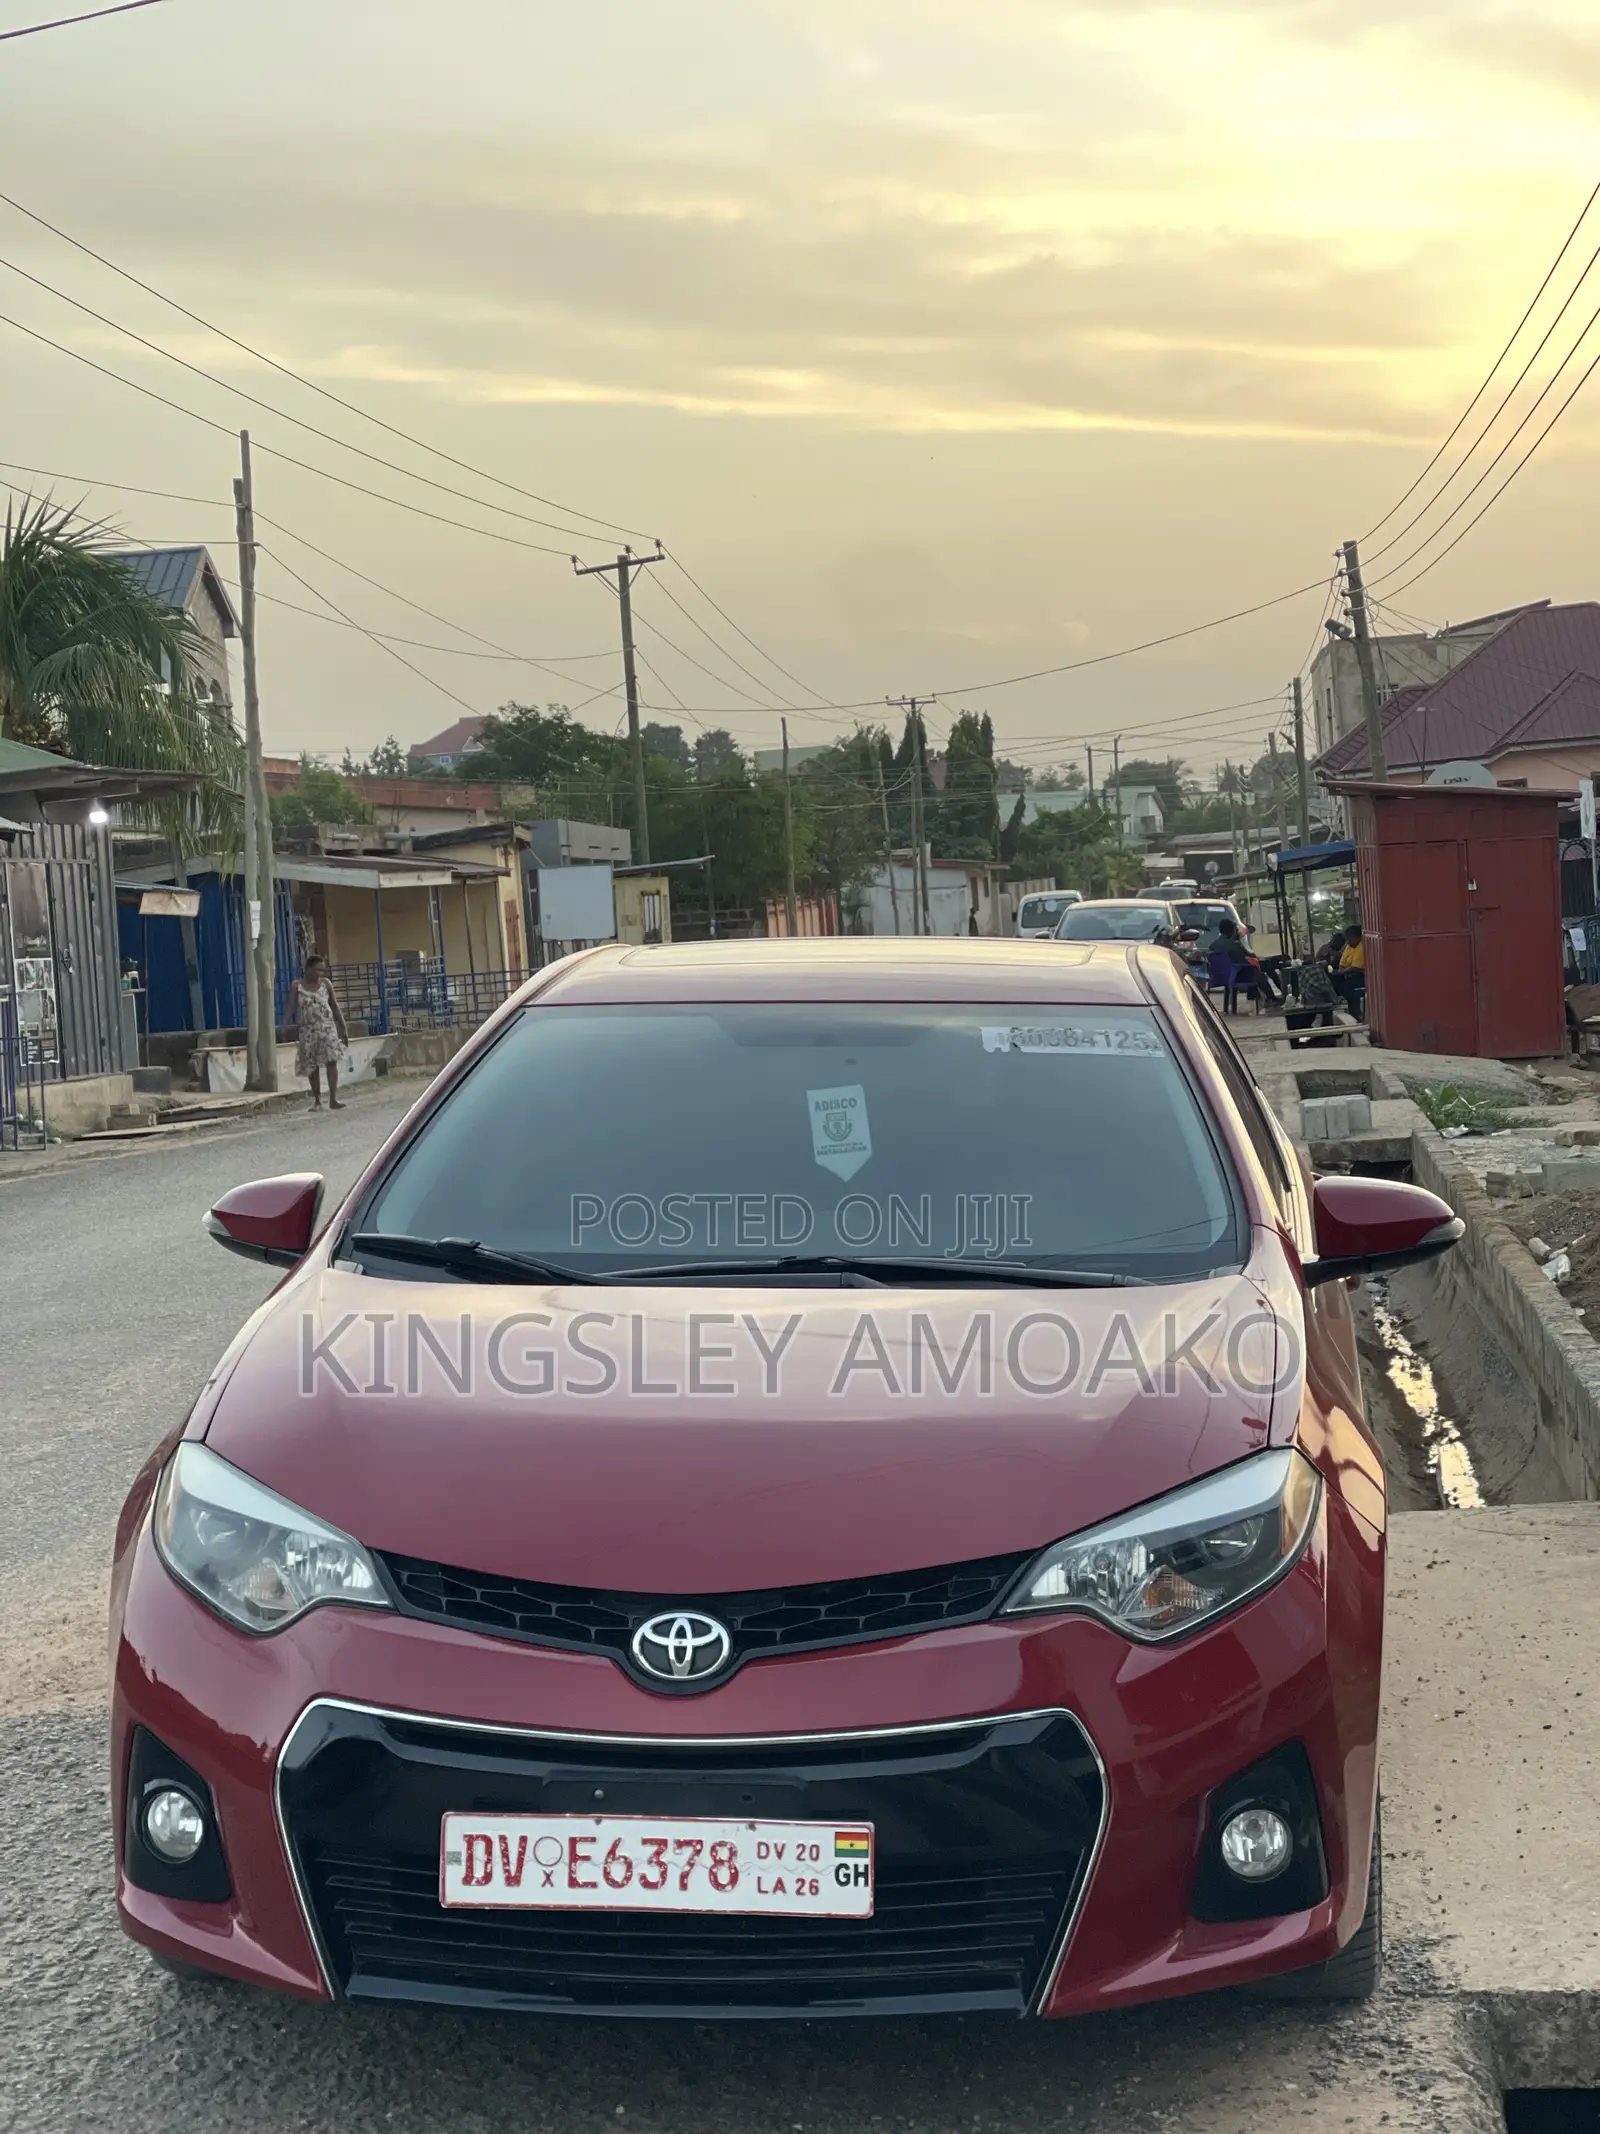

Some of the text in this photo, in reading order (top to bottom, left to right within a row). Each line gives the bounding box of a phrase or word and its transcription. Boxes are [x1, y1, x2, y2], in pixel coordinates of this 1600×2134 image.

[814, 1097, 857, 1112] ADISCO
[756, 1840, 821, 1862] DV 20
[461, 1833, 529, 1887] DV
[567, 1836, 739, 1893] E6378
[756, 1875, 820, 1896] LA 26
[834, 1862, 870, 1888] GH
